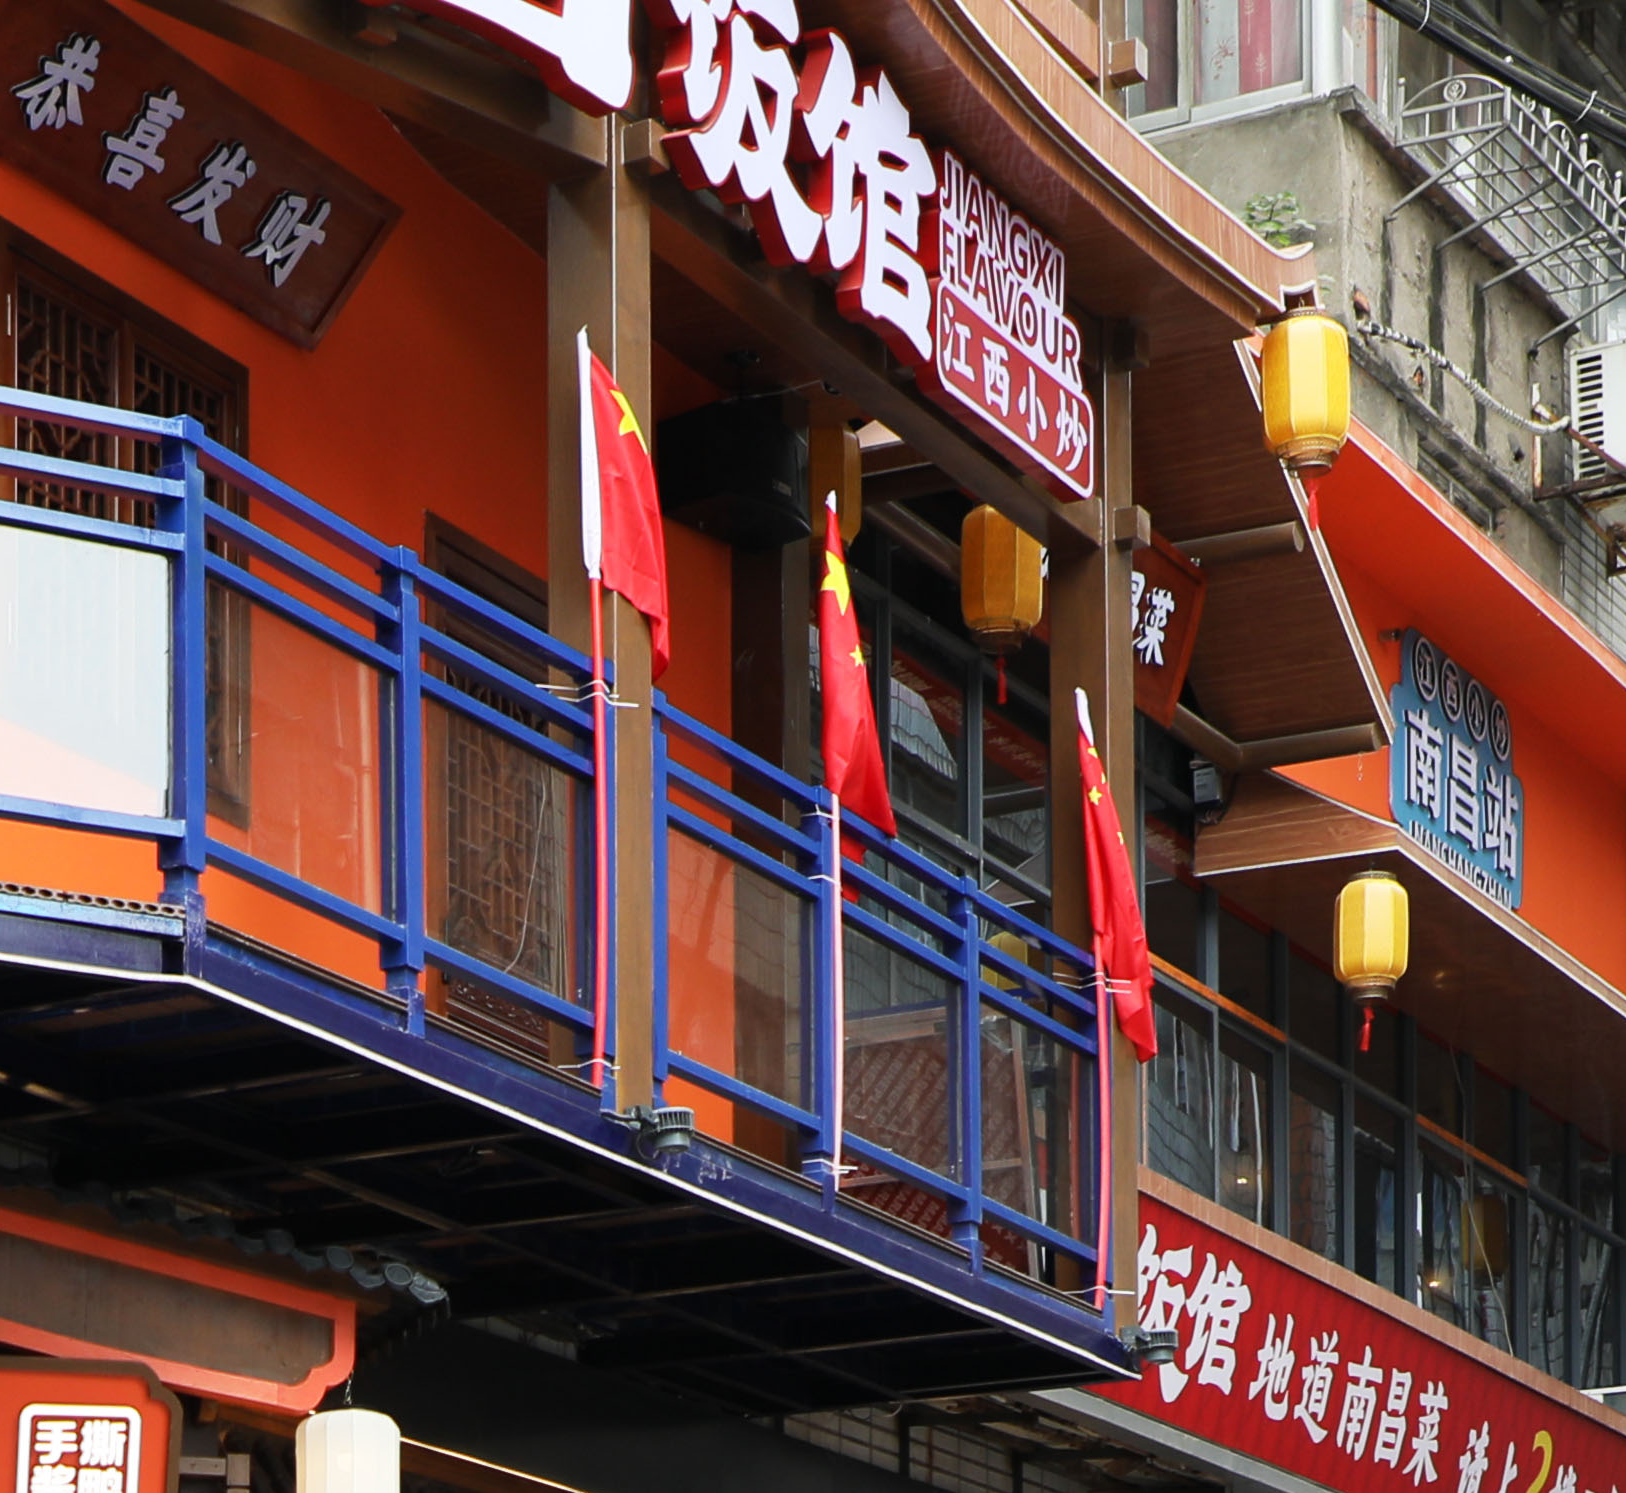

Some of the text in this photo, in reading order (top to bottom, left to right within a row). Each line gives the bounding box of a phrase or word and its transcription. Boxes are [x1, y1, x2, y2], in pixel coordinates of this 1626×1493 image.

[12, 33, 332, 288] 恭喜发财
[940, 152, 1065, 310] JIANGXI
[940, 212, 1081, 390] FLAVOUR
[943, 297, 1089, 472] 江西小炒
[1405, 708, 1521, 880] 南昌站
[32, 1416, 127, 1466] 手撕
[1248, 1312, 1449, 1488] 地道南昌菜
